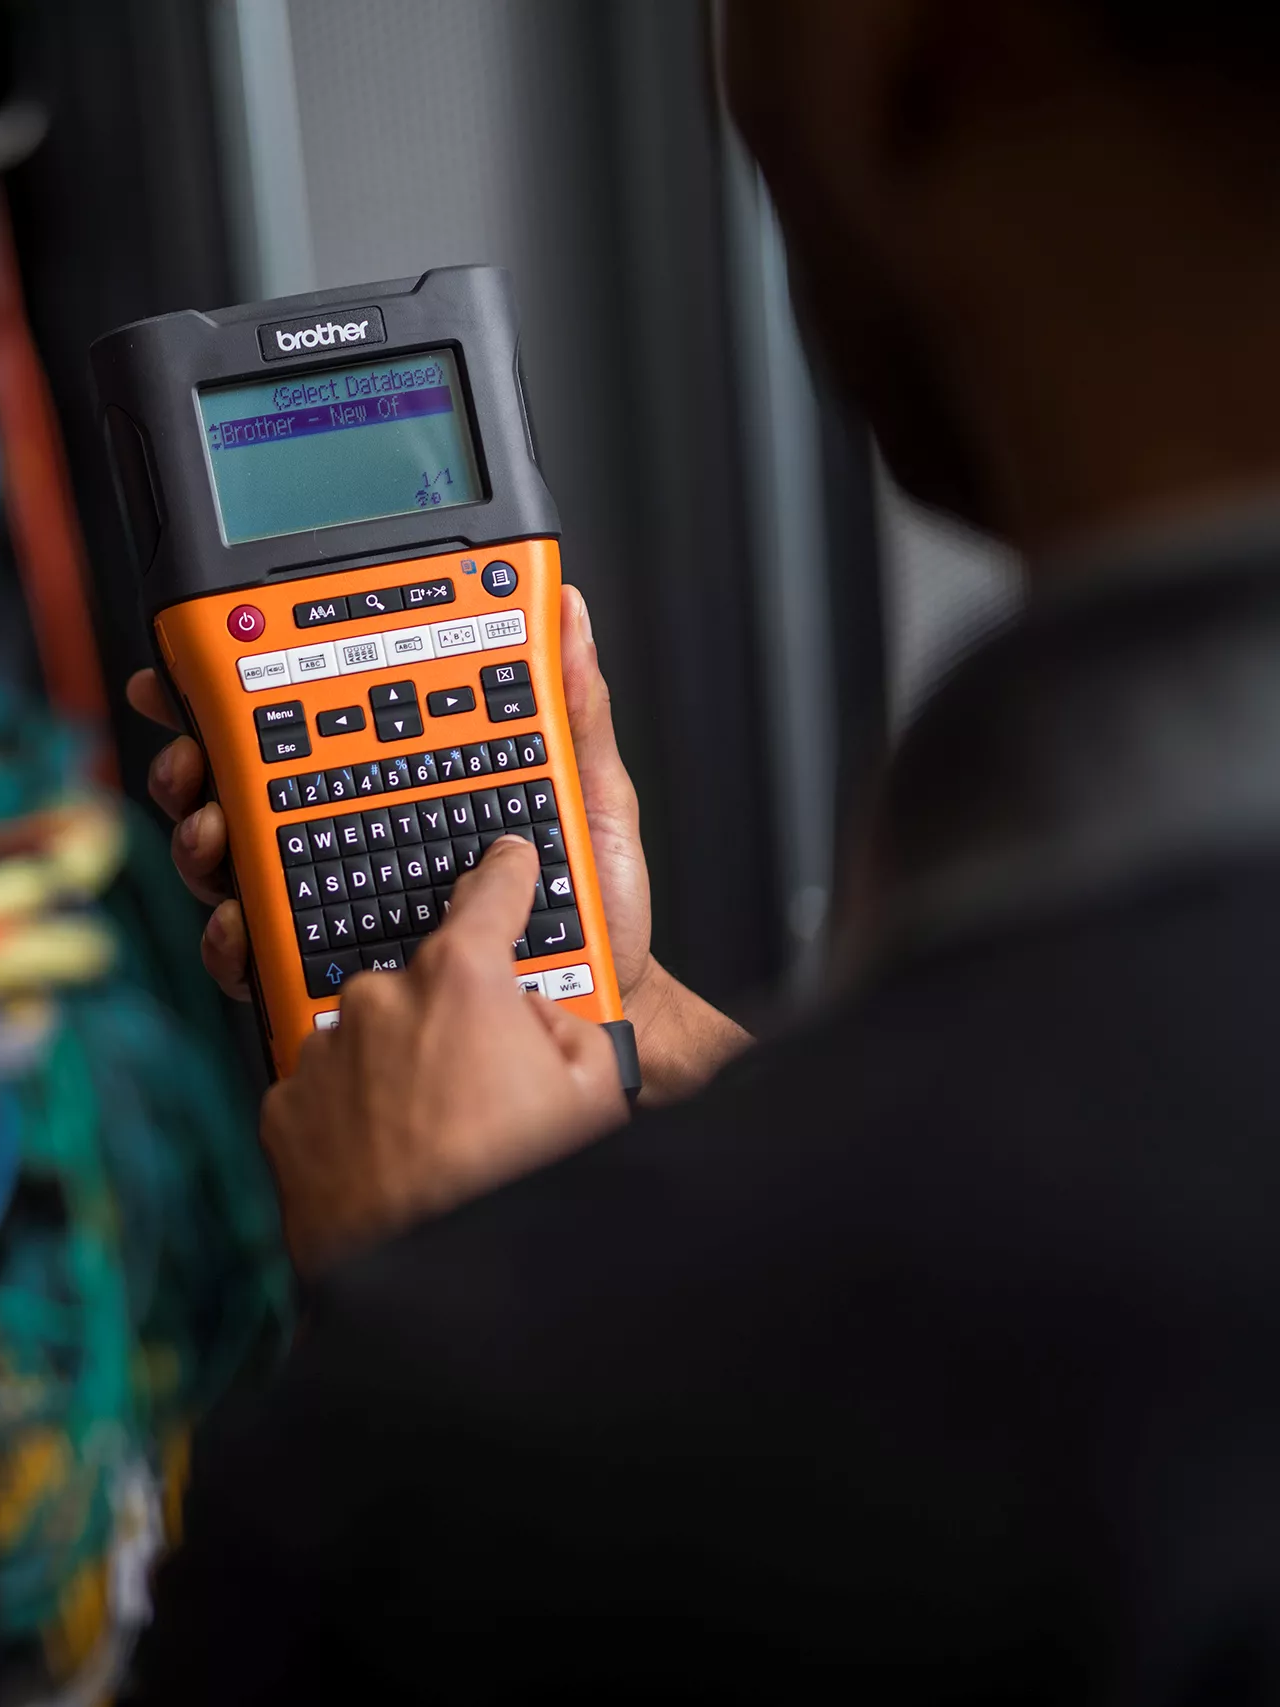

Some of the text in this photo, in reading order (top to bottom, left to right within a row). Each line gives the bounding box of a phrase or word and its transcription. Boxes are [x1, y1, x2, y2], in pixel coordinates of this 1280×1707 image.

[276, 320, 369, 352] brother
[223, 416, 295, 445] Brother
[329, 404, 367, 428] New
[377, 397, 400, 419] Of
[422, 468, 453, 488] 1/1
[399, 642, 413, 650] ABC
[305, 660, 321, 669] ABC
[246, 669, 261, 678] ABC
[267, 710, 293, 721] Menu
[504, 703, 520, 713] OK
[278, 744, 296, 753] Esc
[279, 748, 534, 805] 1 2 3 4 5 6 7 8 9 0
[289, 794, 547, 852] Q W E R T Y U I O P
[299, 882, 312, 897] A
[326, 876, 338, 891] S
[353, 872, 366, 886] D
[381, 866, 392, 881] F
[408, 862, 422, 876] G
[435, 856, 449, 871] H
[465, 852, 474, 866] J
[307, 925, 320, 940] Z
[335, 919, 347, 935] X
[362, 915, 375, 929] C
[389, 909, 400, 924] V
[417, 905, 429, 919] B
[559, 983, 581, 992] WiFi
